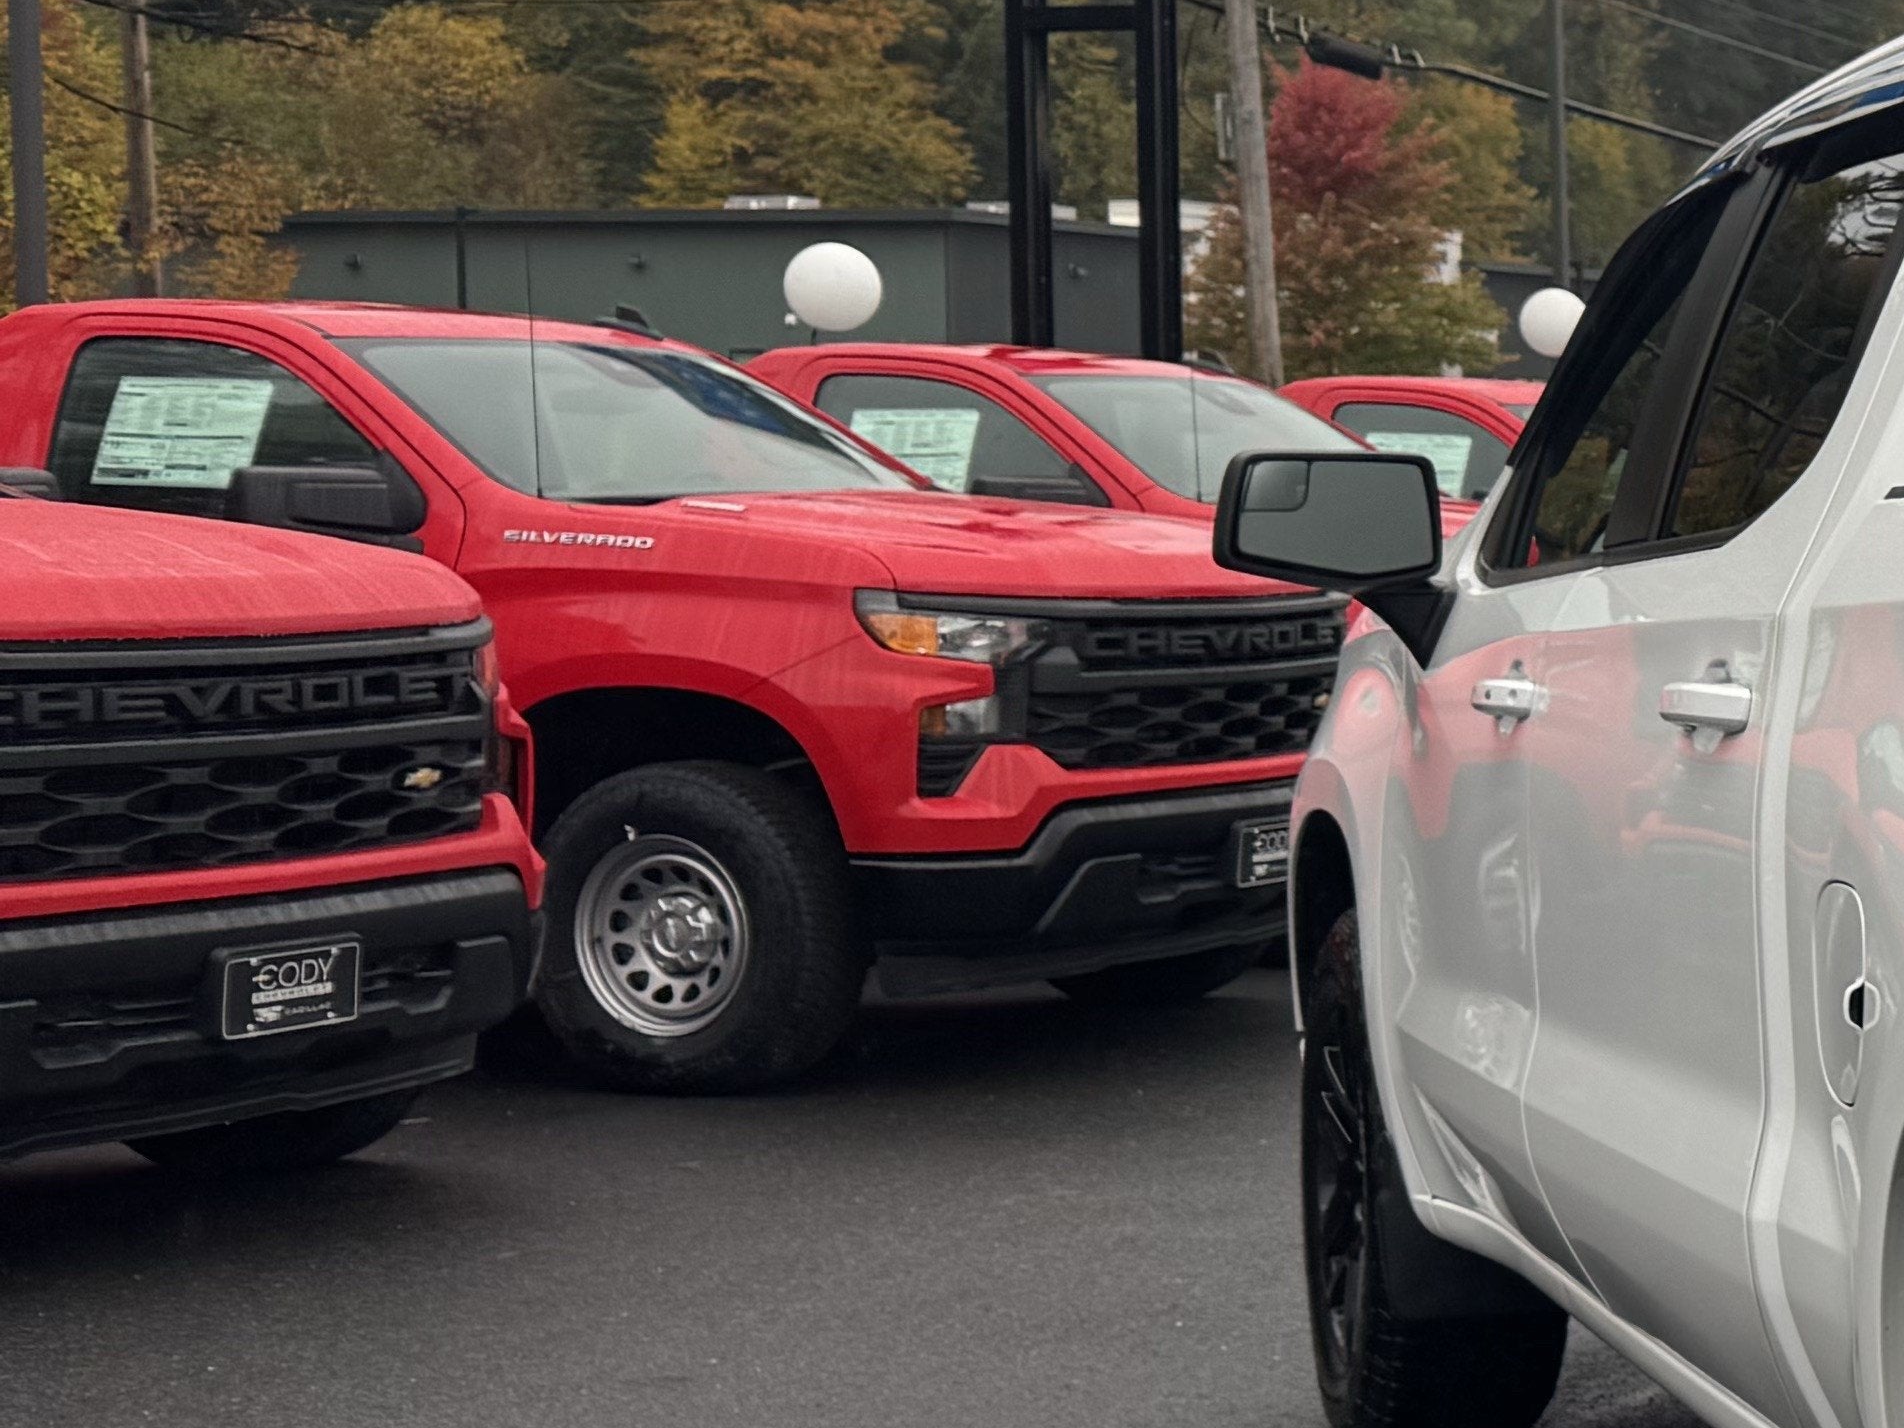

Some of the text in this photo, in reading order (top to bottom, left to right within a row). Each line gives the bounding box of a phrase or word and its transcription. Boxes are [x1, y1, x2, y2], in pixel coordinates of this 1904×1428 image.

[503, 529, 655, 550] SILVERADO
[1088, 619, 1345, 656] CHEVROLE
[256, 955, 334, 990] CODY
